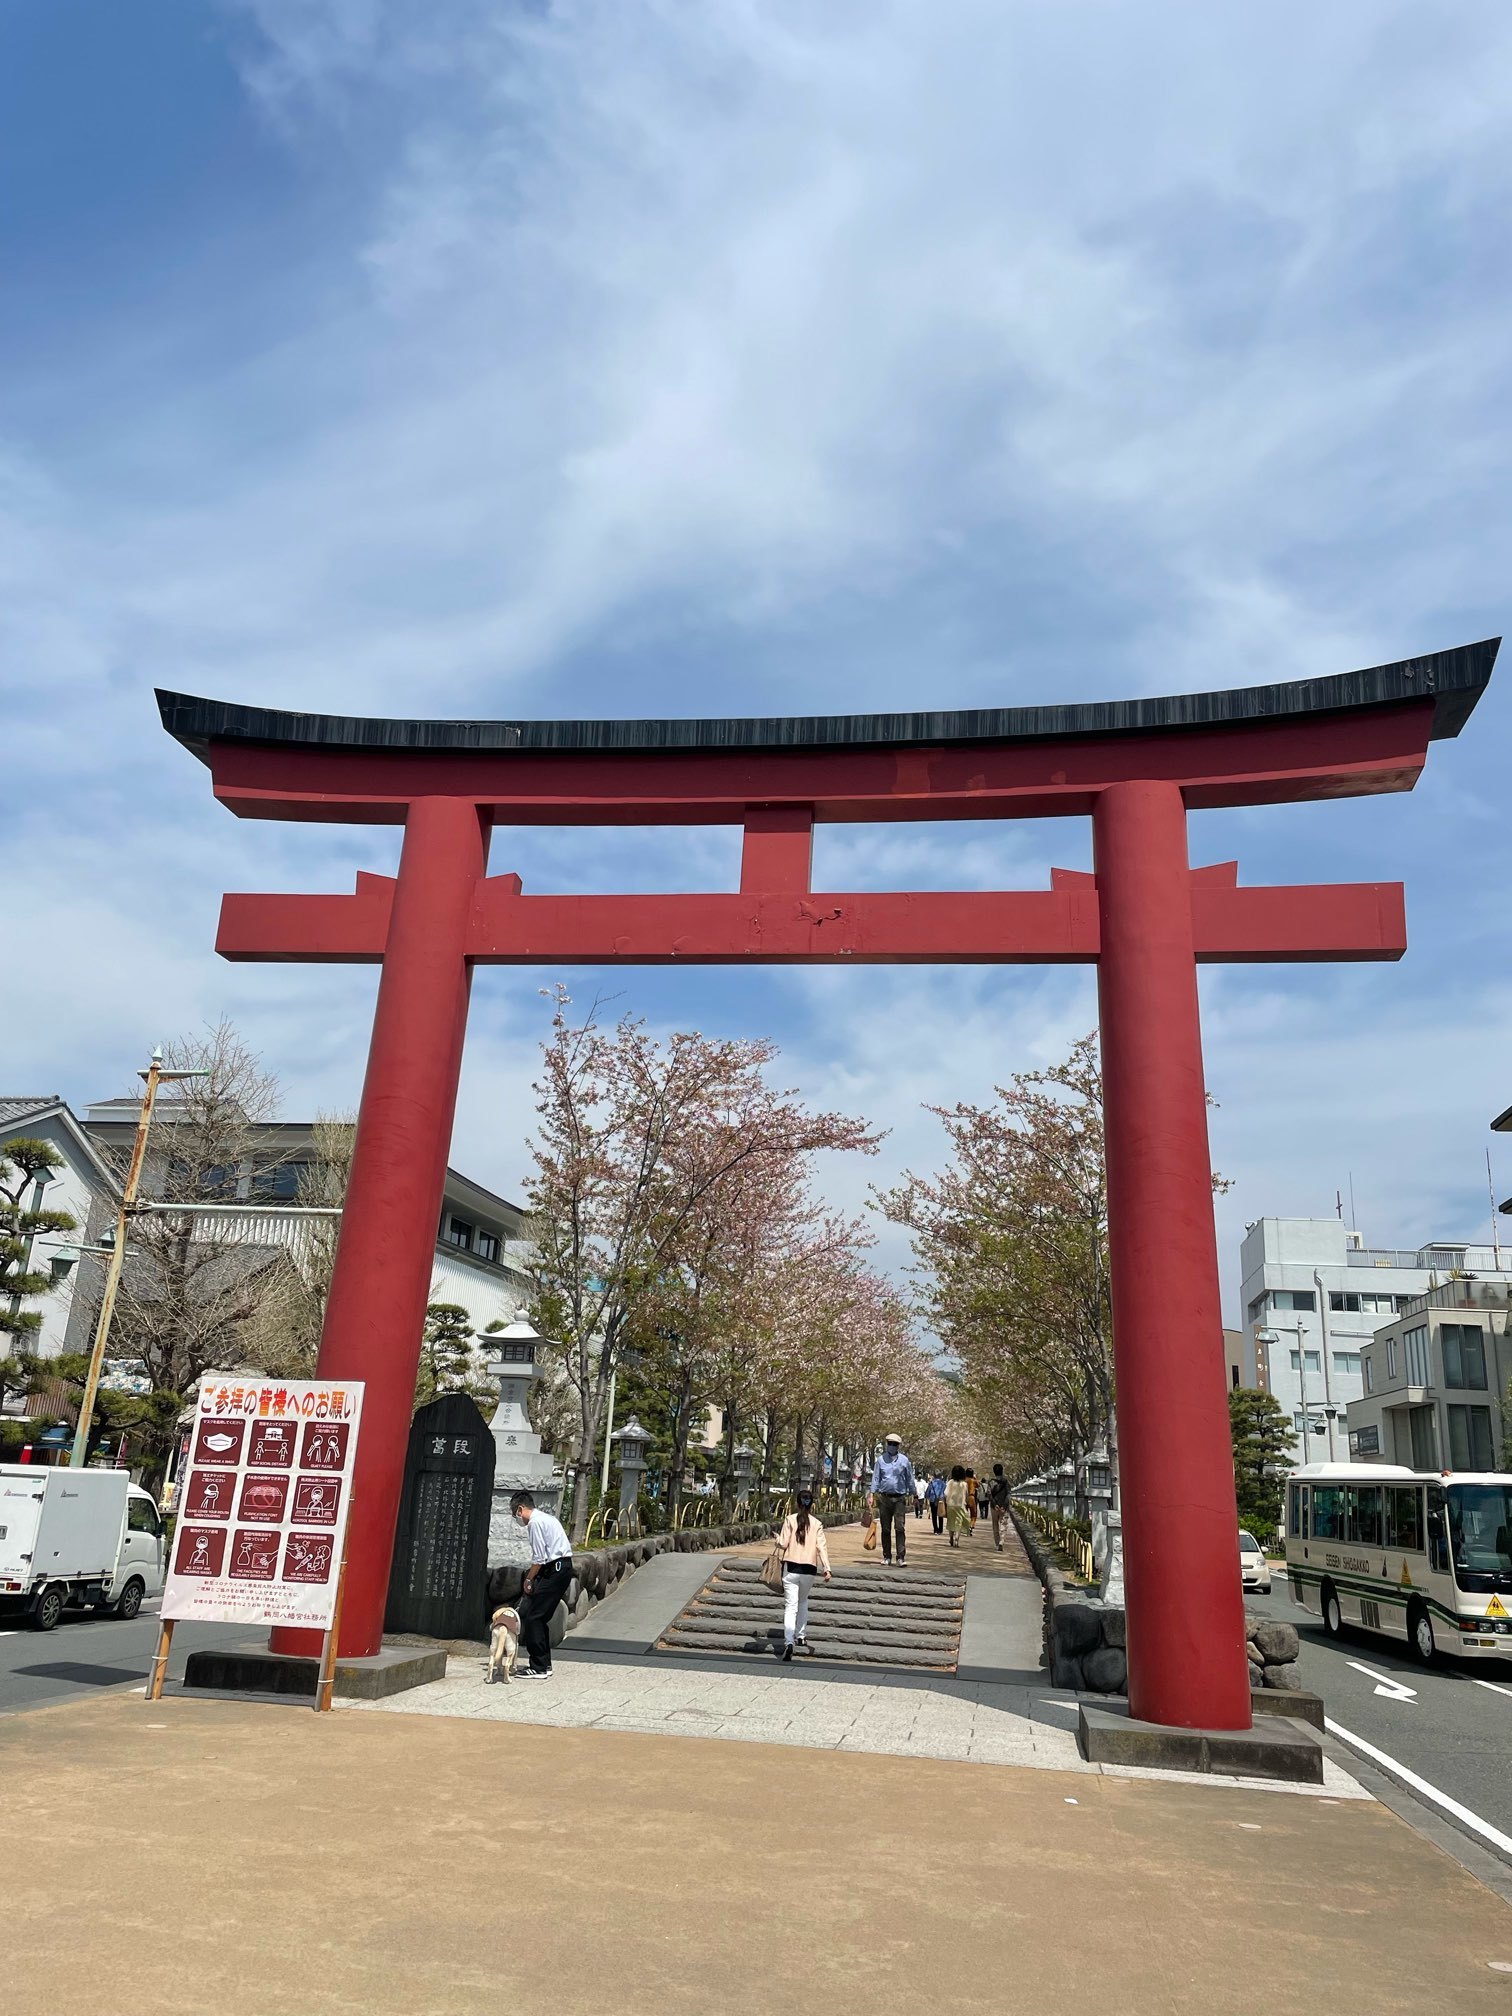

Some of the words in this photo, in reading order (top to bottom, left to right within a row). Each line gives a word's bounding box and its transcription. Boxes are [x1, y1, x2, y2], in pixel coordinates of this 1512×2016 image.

[201, 1384, 356, 1419] ご参拝の皆様へのお願い
[263, 1611, 328, 1622] 鶴岡八幡宮社務所
